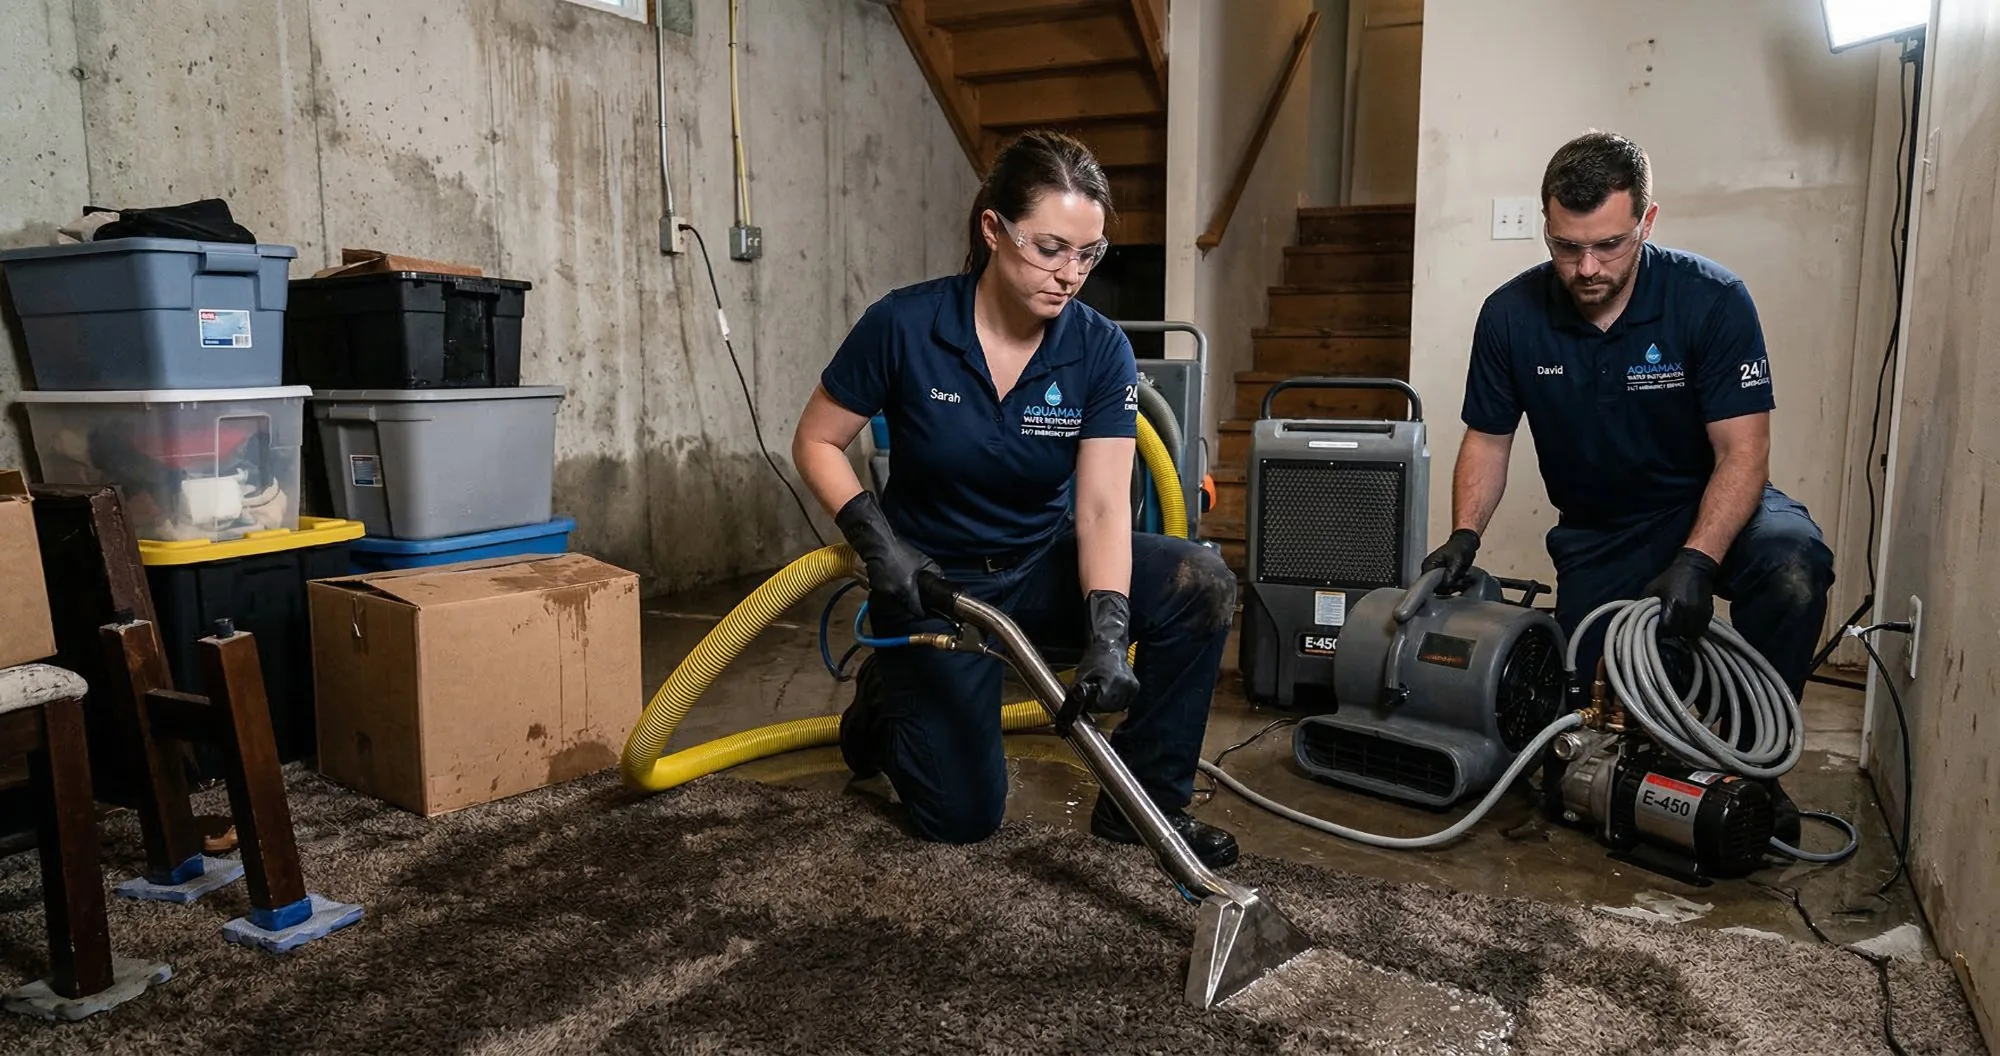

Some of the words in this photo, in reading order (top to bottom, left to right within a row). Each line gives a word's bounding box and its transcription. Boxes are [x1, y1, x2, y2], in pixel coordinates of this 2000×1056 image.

[1537, 365, 1563, 375] David
[1626, 362, 1683, 375] AQUAMAX
[930, 388, 961, 403] Sarah
[1023, 405, 1083, 418] AQUAMAX
[1642, 790, 1691, 817] E-450
